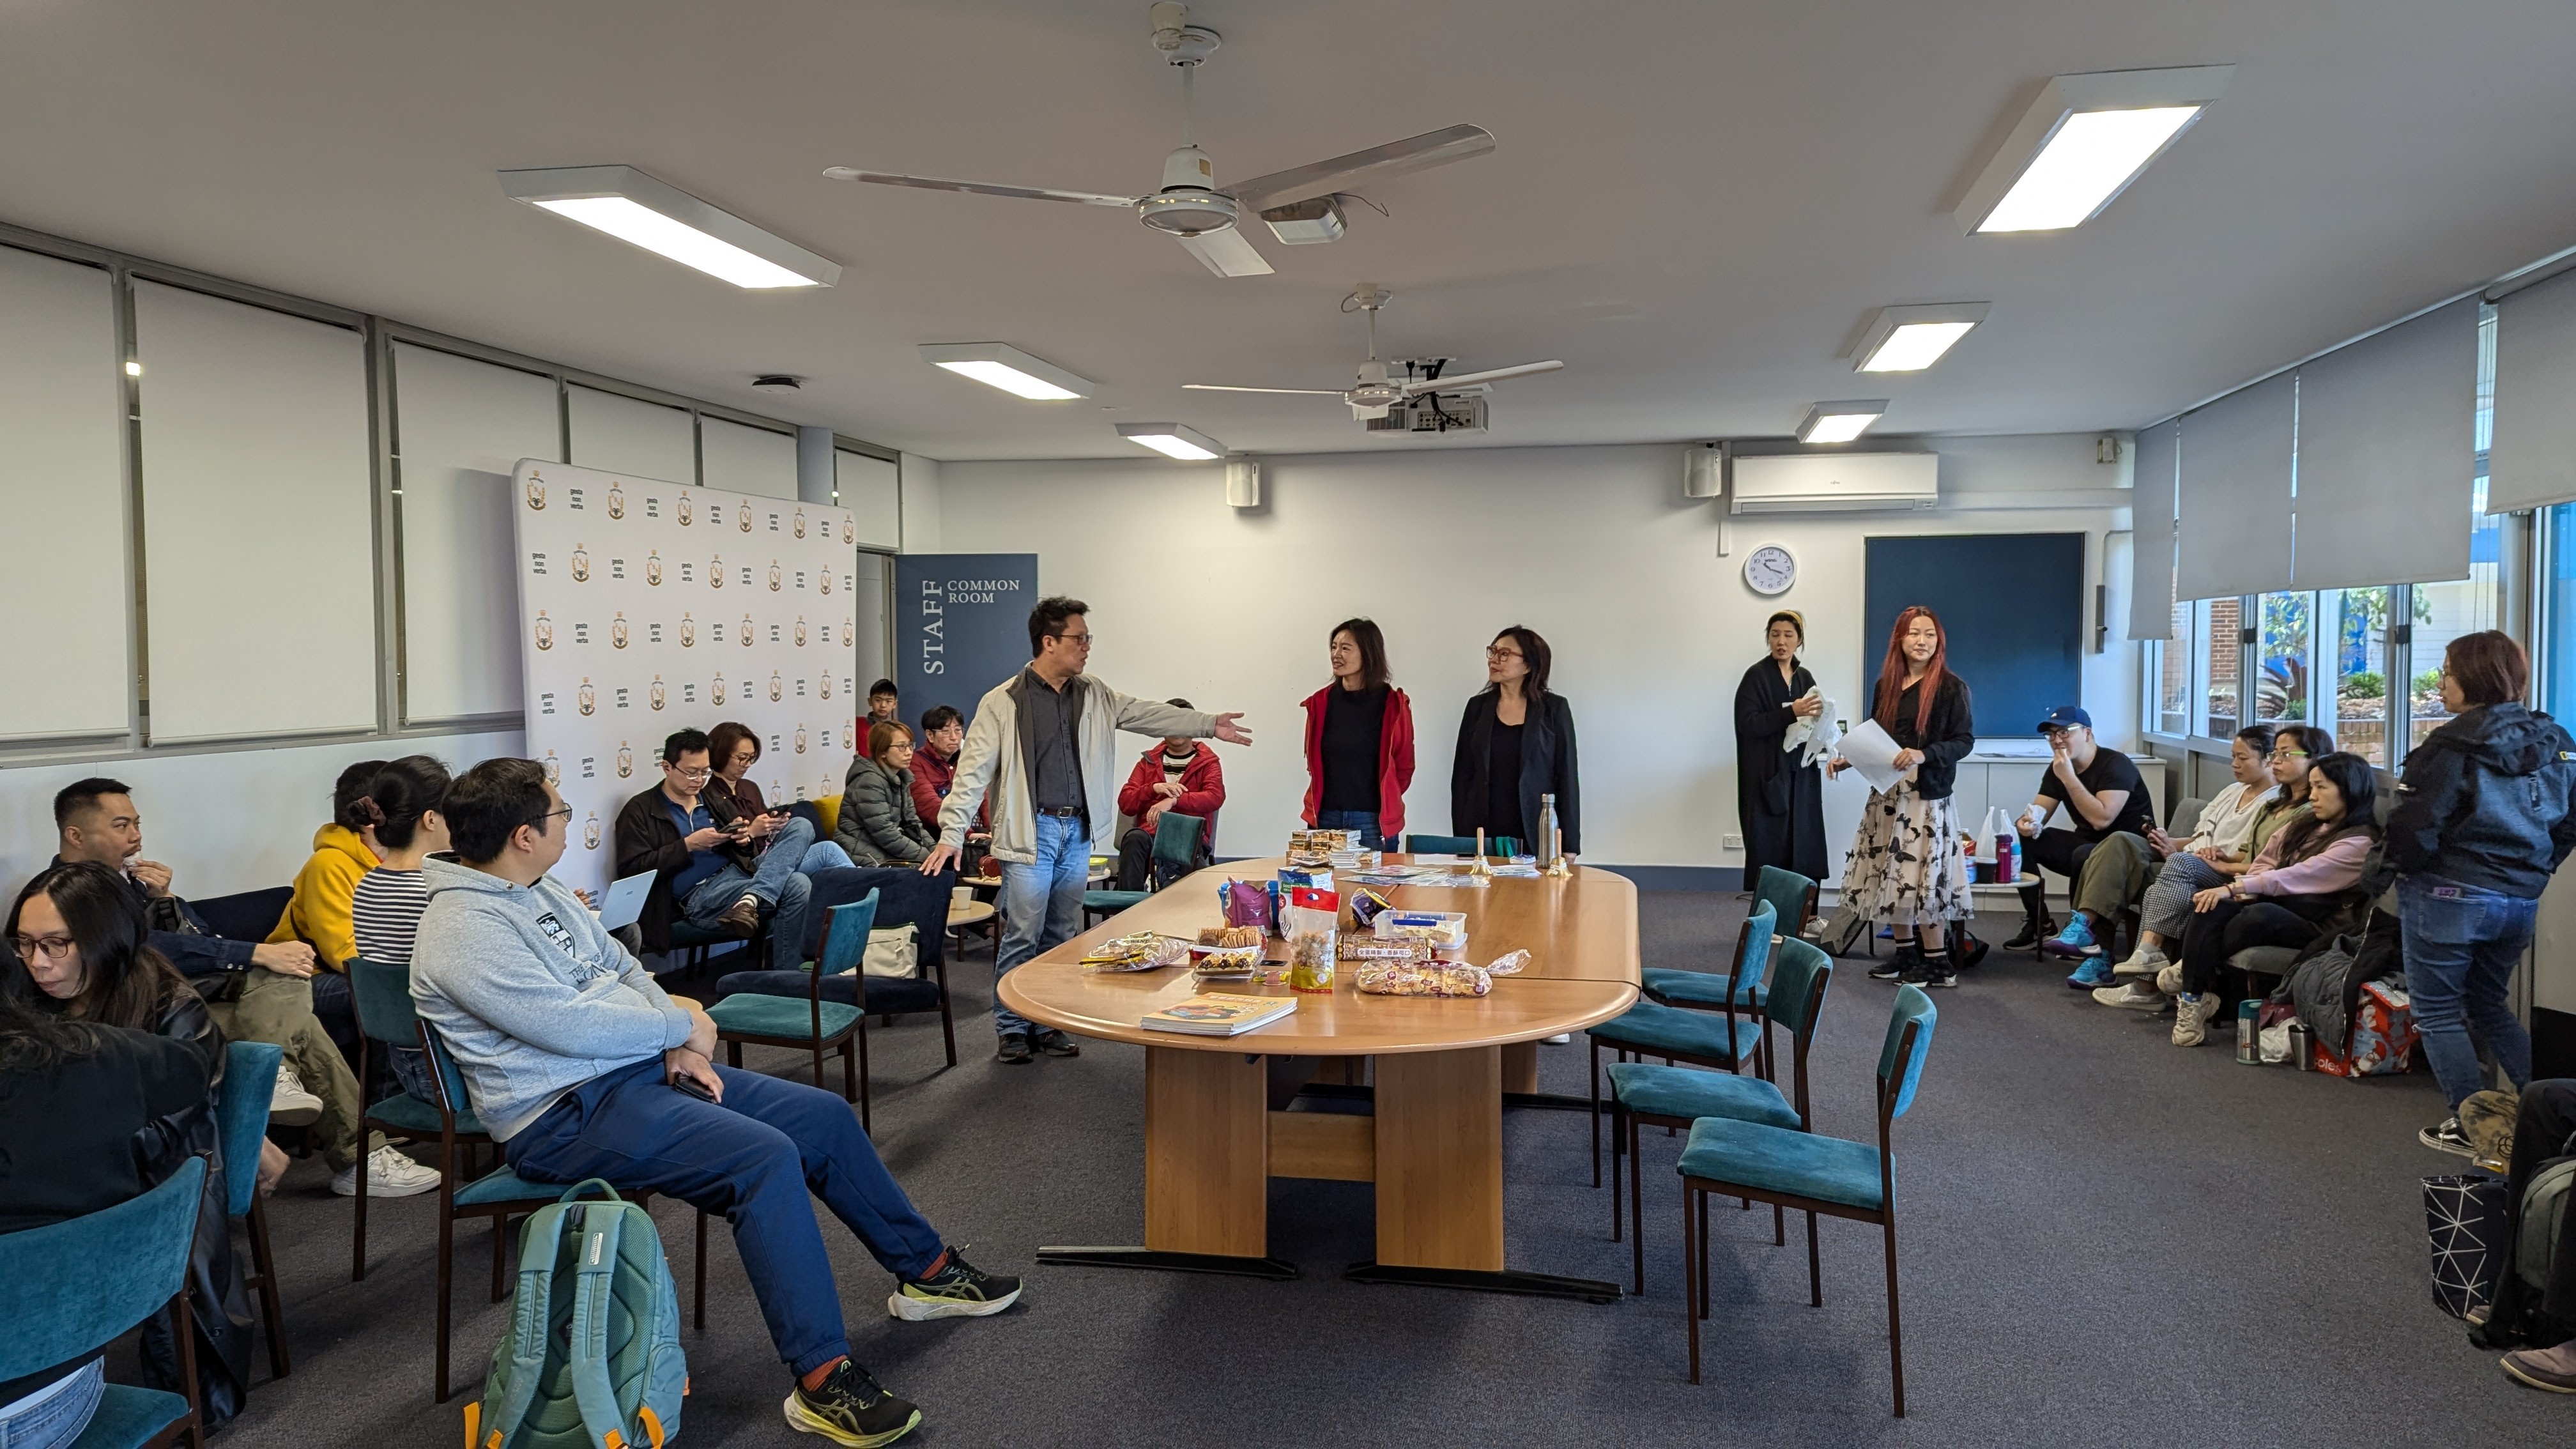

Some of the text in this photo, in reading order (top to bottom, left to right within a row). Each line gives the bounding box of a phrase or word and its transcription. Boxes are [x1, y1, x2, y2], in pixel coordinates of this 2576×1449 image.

[947, 579, 1020, 591] COMMON
[948, 592, 995, 604] ROOM
[922, 579, 944, 675] STAFF
[541, 693, 554, 701] gesta
[569, 963, 585, 979] THE
